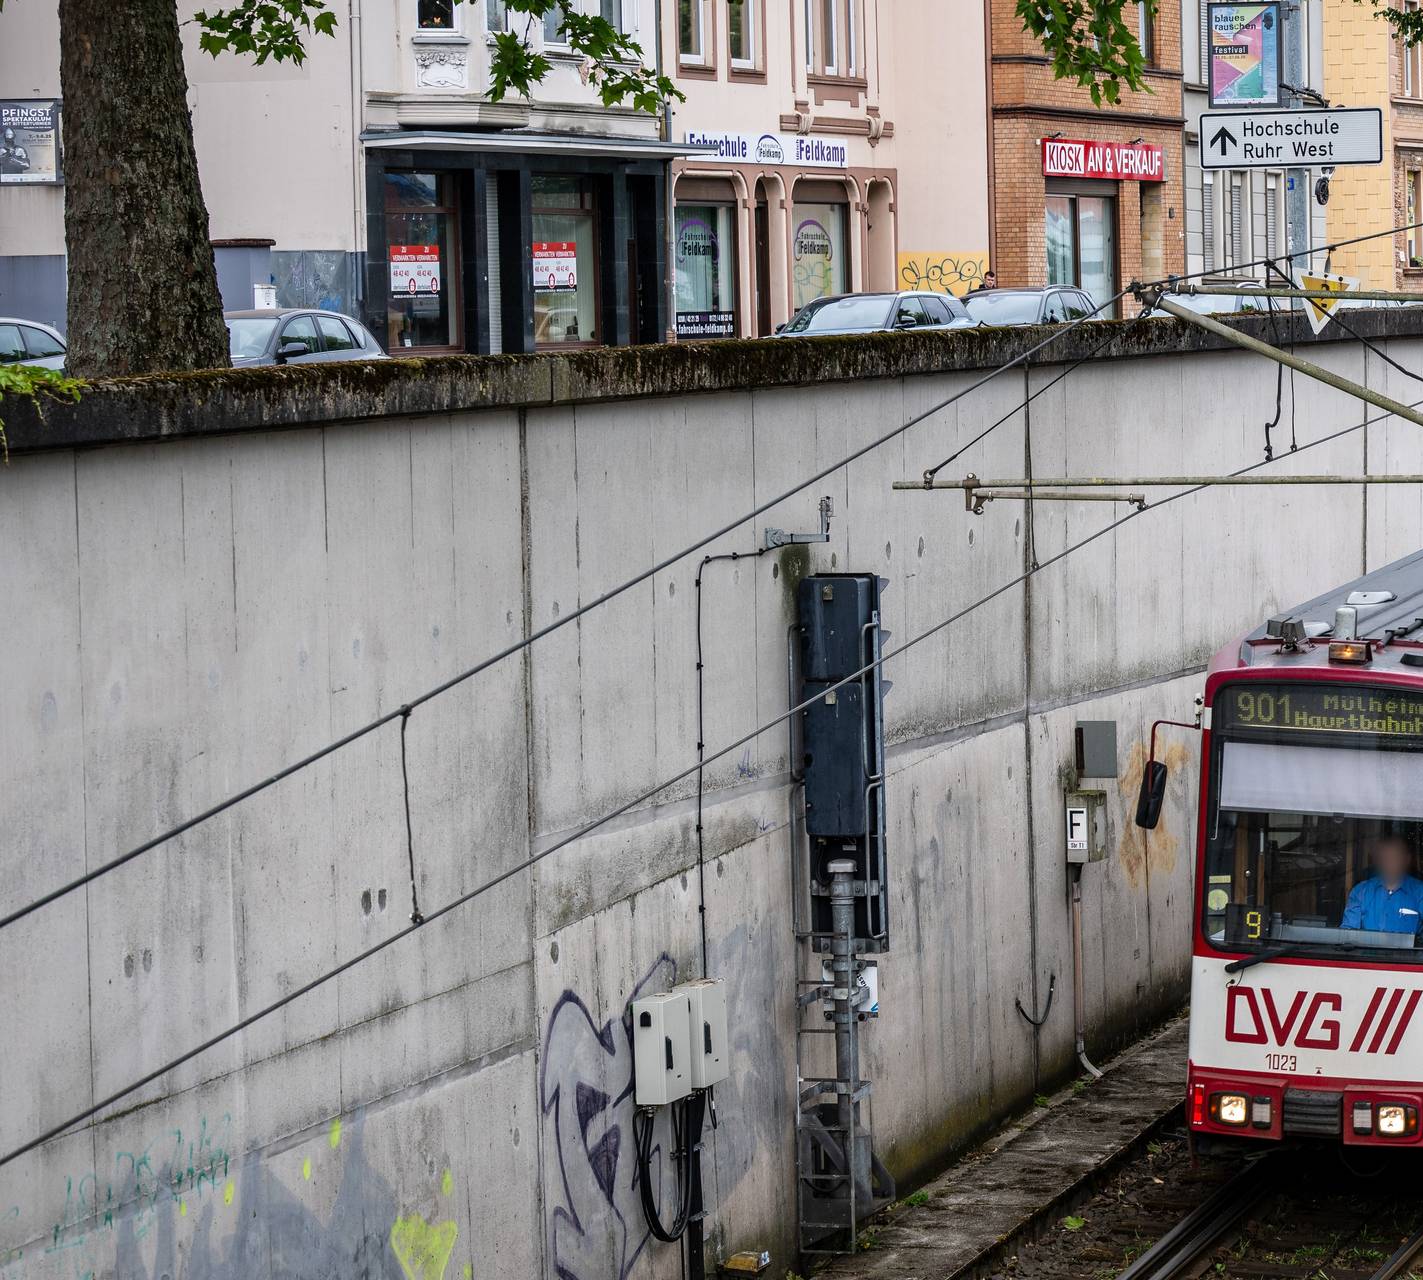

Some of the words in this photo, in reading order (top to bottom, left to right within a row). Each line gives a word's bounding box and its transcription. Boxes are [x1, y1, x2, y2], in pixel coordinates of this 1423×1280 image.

[1215, 14, 1245, 22] blaues
[1215, 23, 1257, 31] rauschen
[2, 108, 51, 117] PFINGST
[1243, 118, 1339, 137] Hochschule
[799, 139, 846, 167] Feldkamp
[1243, 142, 1283, 159] Ruhr
[1292, 141, 1334, 157] West
[1048, 144, 1082, 172] KIOSK
[1087, 146, 1103, 173] AN
[1105, 147, 1114, 173] &
[1115, 148, 1161, 176] VERKAUF
[800, 241, 830, 258] Feldkamp
[1237, 691, 1290, 724] 901
[1069, 810, 1084, 839] F
[1246, 911, 1261, 939] 9
[1225, 985, 1342, 1051] DVG
[1265, 1053, 1297, 1072] 1023
